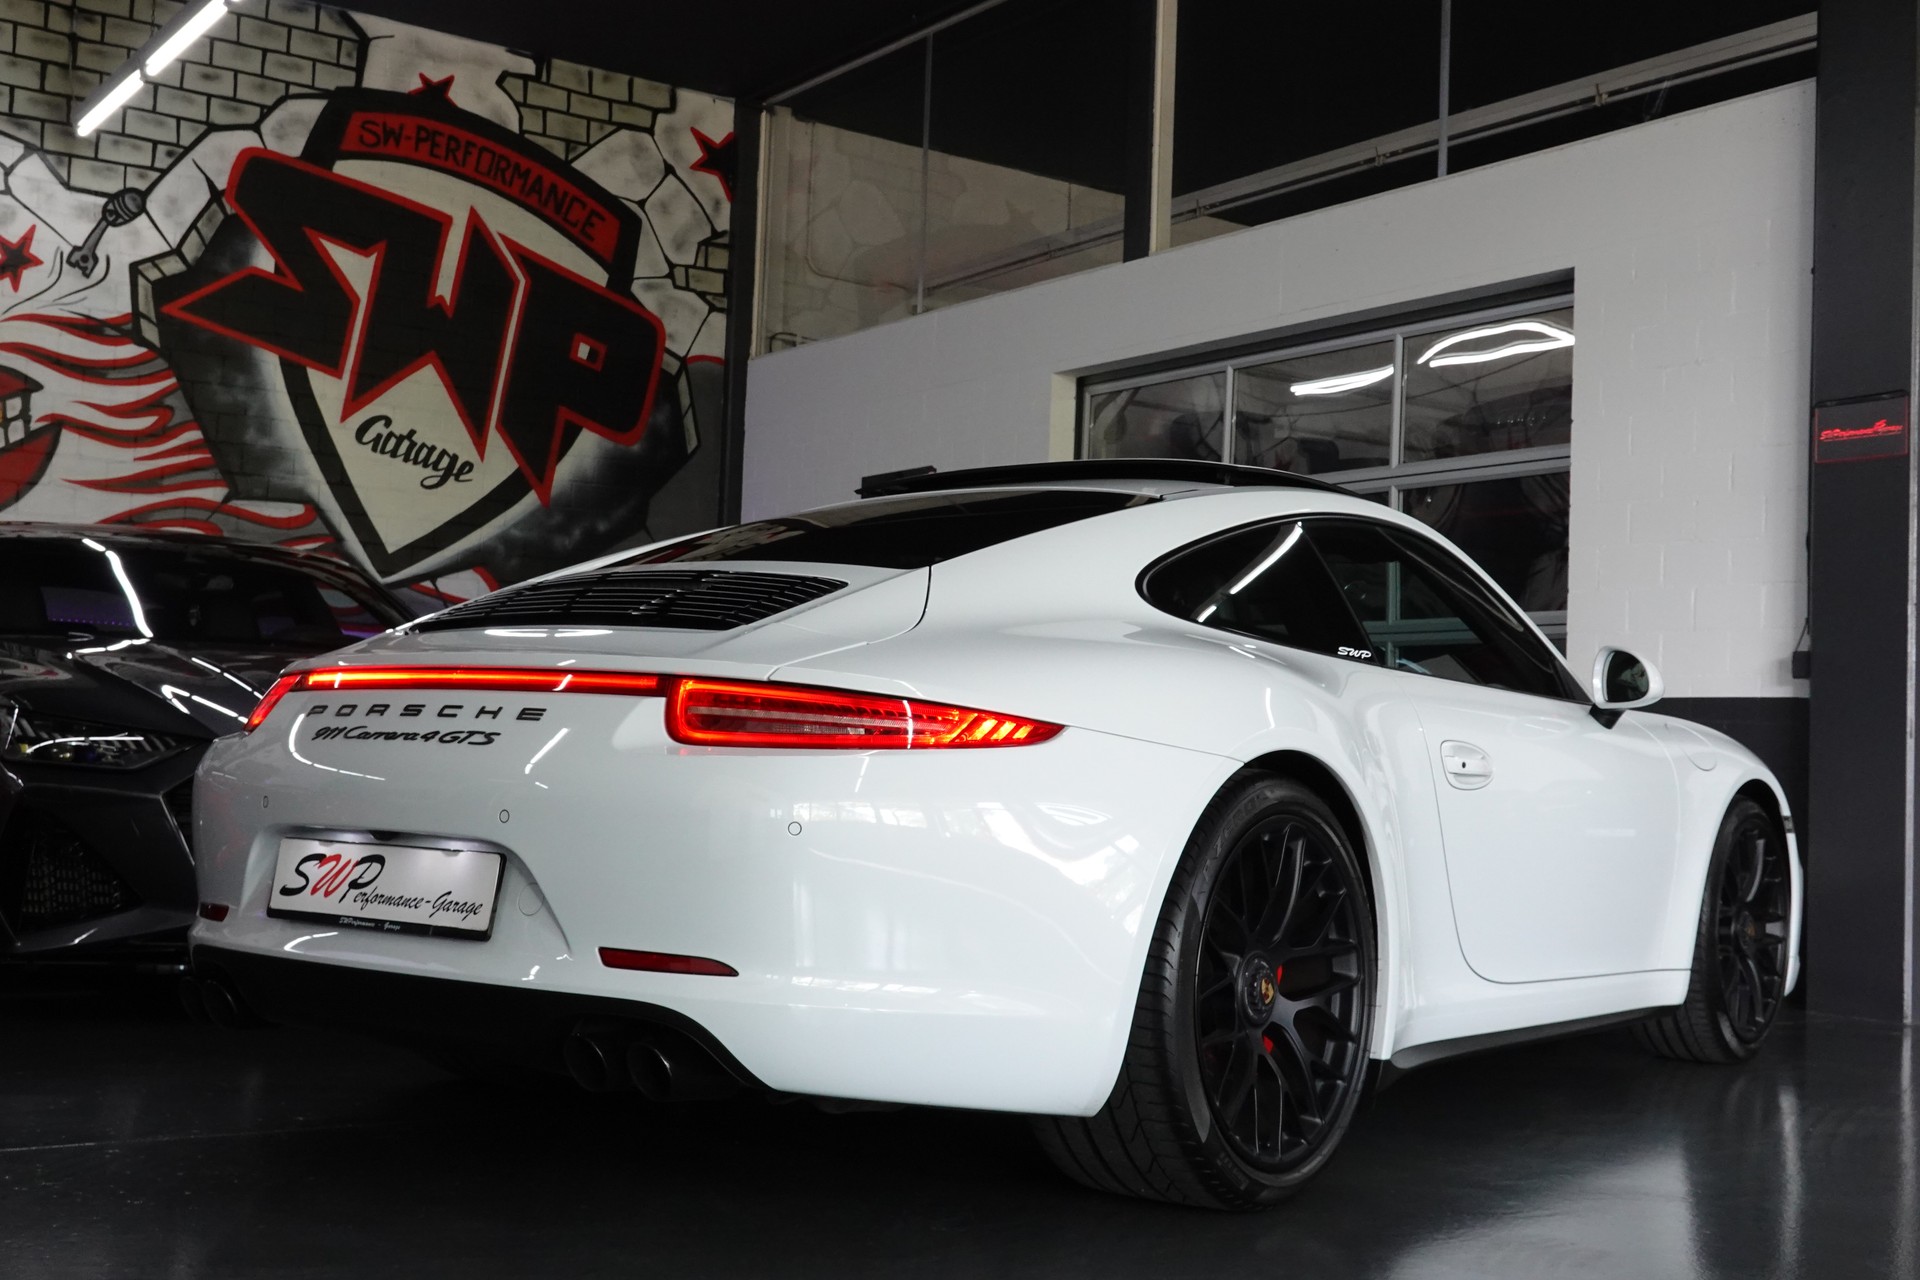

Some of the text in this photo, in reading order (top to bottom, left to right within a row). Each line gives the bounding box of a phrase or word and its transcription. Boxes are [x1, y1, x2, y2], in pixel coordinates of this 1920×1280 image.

[358, 119, 606, 242] SW-PERFORMANCE
[160, 147, 665, 507] SWP
[355, 415, 474, 490] Garage
[1337, 646, 1372, 659] SWP
[306, 704, 547, 722] PORSCHE
[438, 731, 501, 746] GTS
